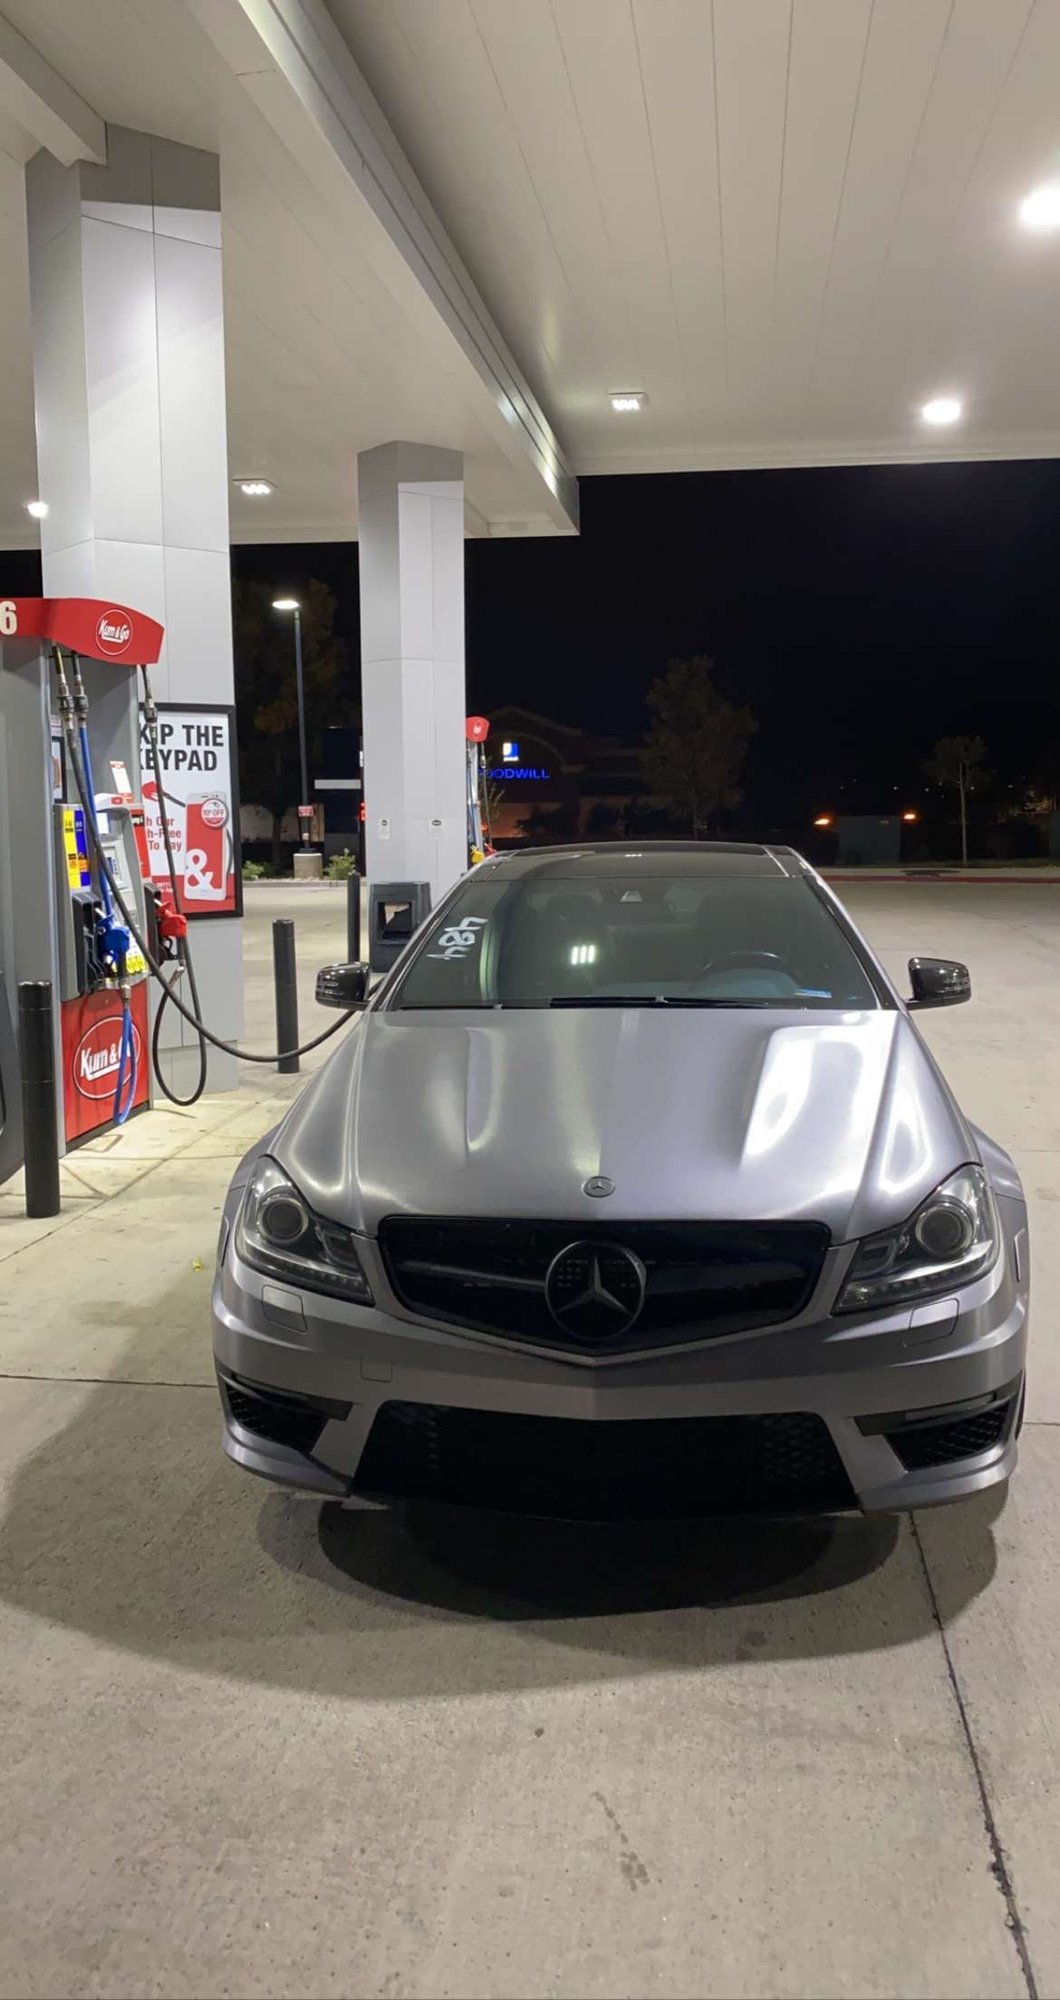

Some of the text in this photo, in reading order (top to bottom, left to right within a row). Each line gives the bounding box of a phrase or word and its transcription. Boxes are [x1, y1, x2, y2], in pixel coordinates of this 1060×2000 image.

[0, 601, 17, 635] 6
[182, 724, 224, 747] THE
[164, 841, 182, 852] ay
